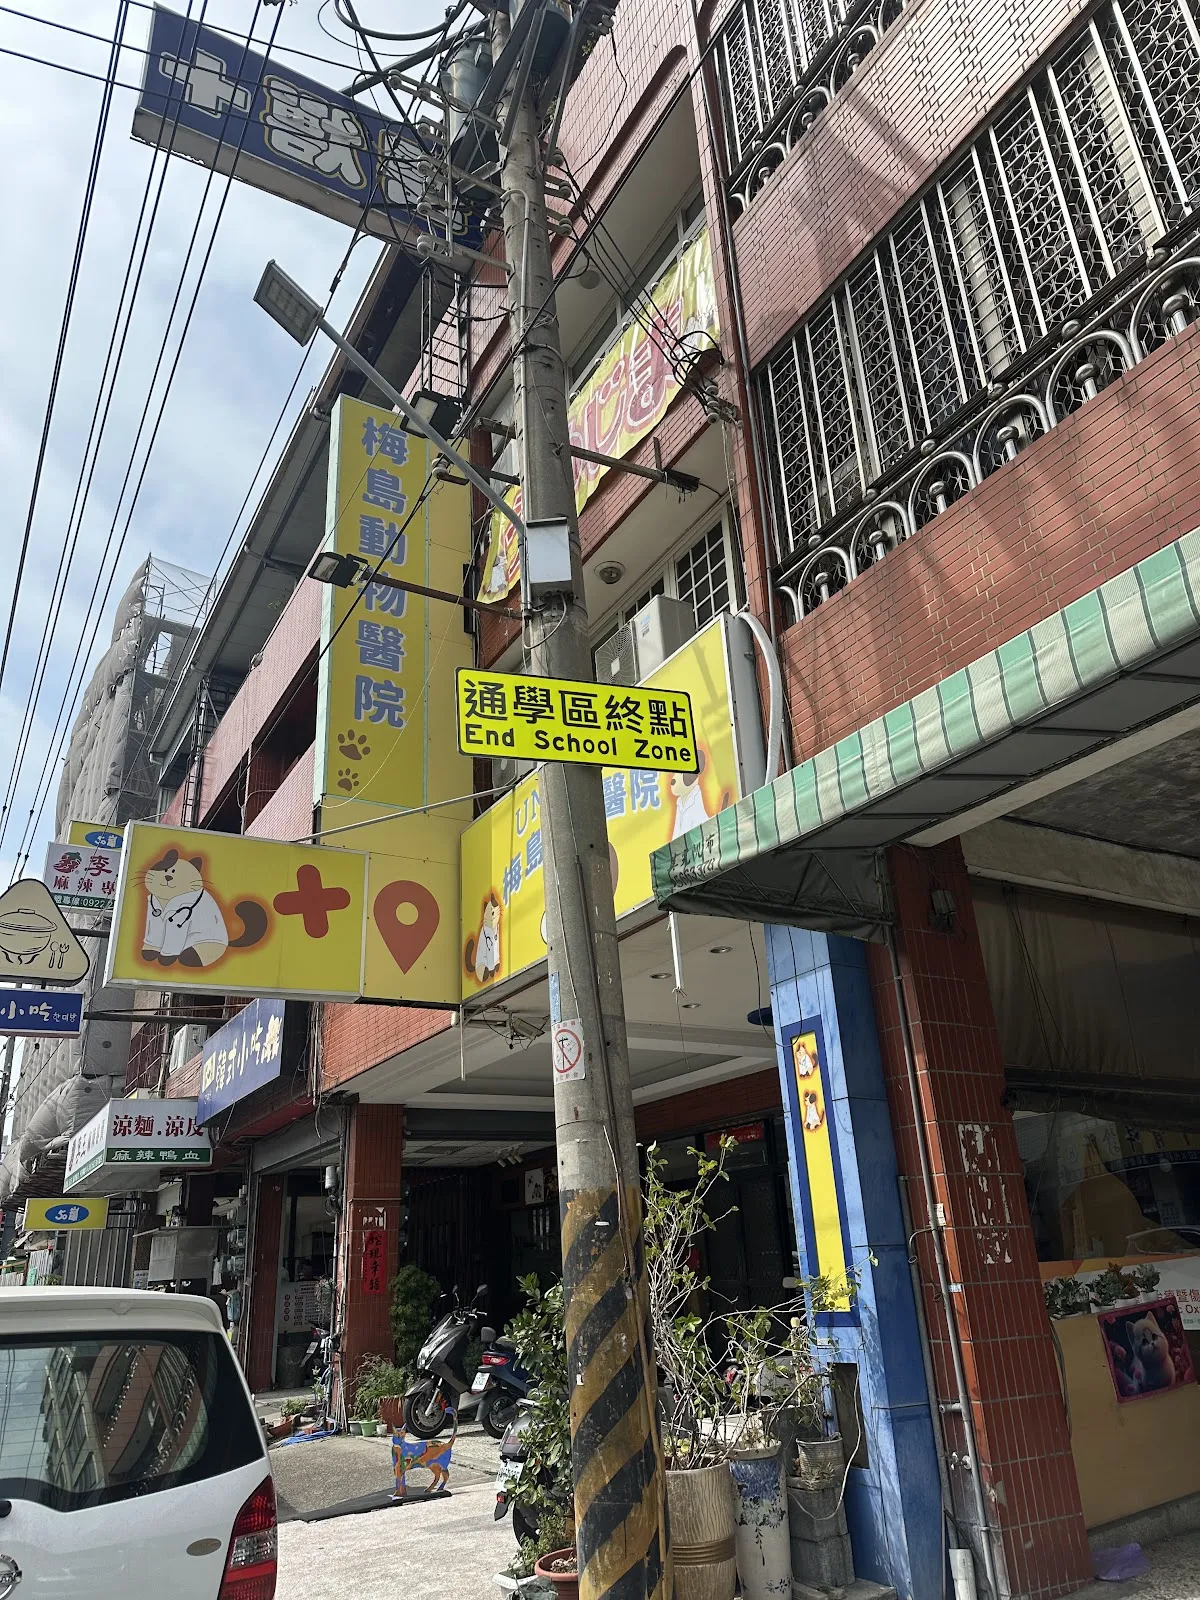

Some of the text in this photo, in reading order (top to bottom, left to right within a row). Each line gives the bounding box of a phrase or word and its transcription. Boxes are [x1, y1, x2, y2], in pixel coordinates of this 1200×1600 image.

[354, 415, 410, 729] 梅島動物醫院
[463, 679, 688, 739] 通學區終點
[465, 723, 692, 762] End School Zone
[94, 834, 118, 848] 50嵐
[503, 768, 661, 906] 梅島 醫院
[53, 875, 116, 895] 麻辣專
[0, 1000, 53, 1022] 小吃
[53, 1012, 78, 1023] 한미방
[111, 1149, 201, 1161] 麻辣鴨血
[55, 1206, 80, 1221] 50嵐
[1185, 1304, 1200, 1314] Ox
